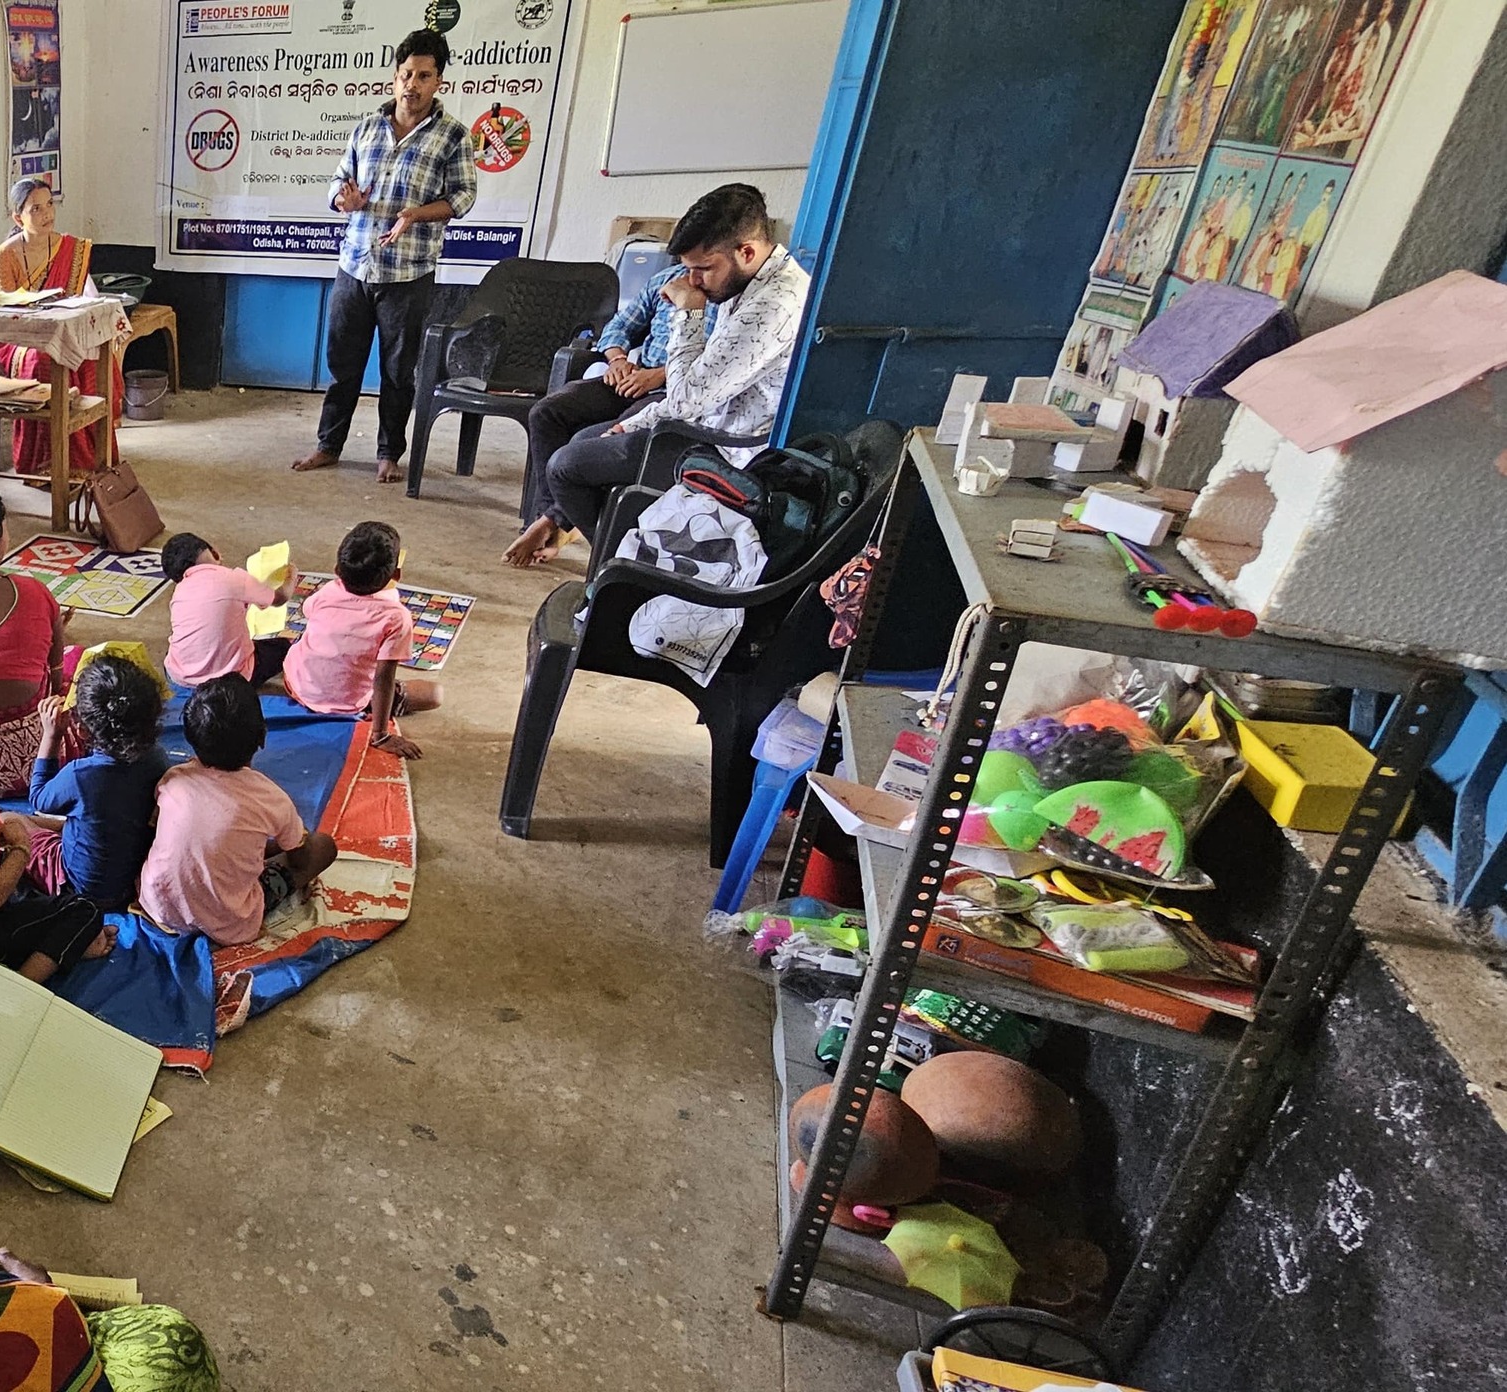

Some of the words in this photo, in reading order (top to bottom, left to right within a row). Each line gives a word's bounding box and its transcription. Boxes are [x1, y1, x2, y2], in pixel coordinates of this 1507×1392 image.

[200, 6, 249, 19] PEOPLE'S
[252, 4, 289, 18] FORUM
[184, 51, 269, 74] Awareness
[273, 48, 348, 76] Program
[353, 51, 374, 69] on
[191, 131, 234, 150] DRUGS
[251, 130, 290, 142] District
[480, 119, 494, 135] NO
[489, 131, 513, 163] DRUGS
[183, 222, 200, 233] Plot
[201, 223, 215, 234] No:
[215, 223, 273, 236] 870/1751/1995,
[476, 230, 517, 244] Balangir
[253, 237, 284, 249] Odisha,
[285, 238, 300, 249] Pin
[1131, 1006, 1177, 1026] COTTON
